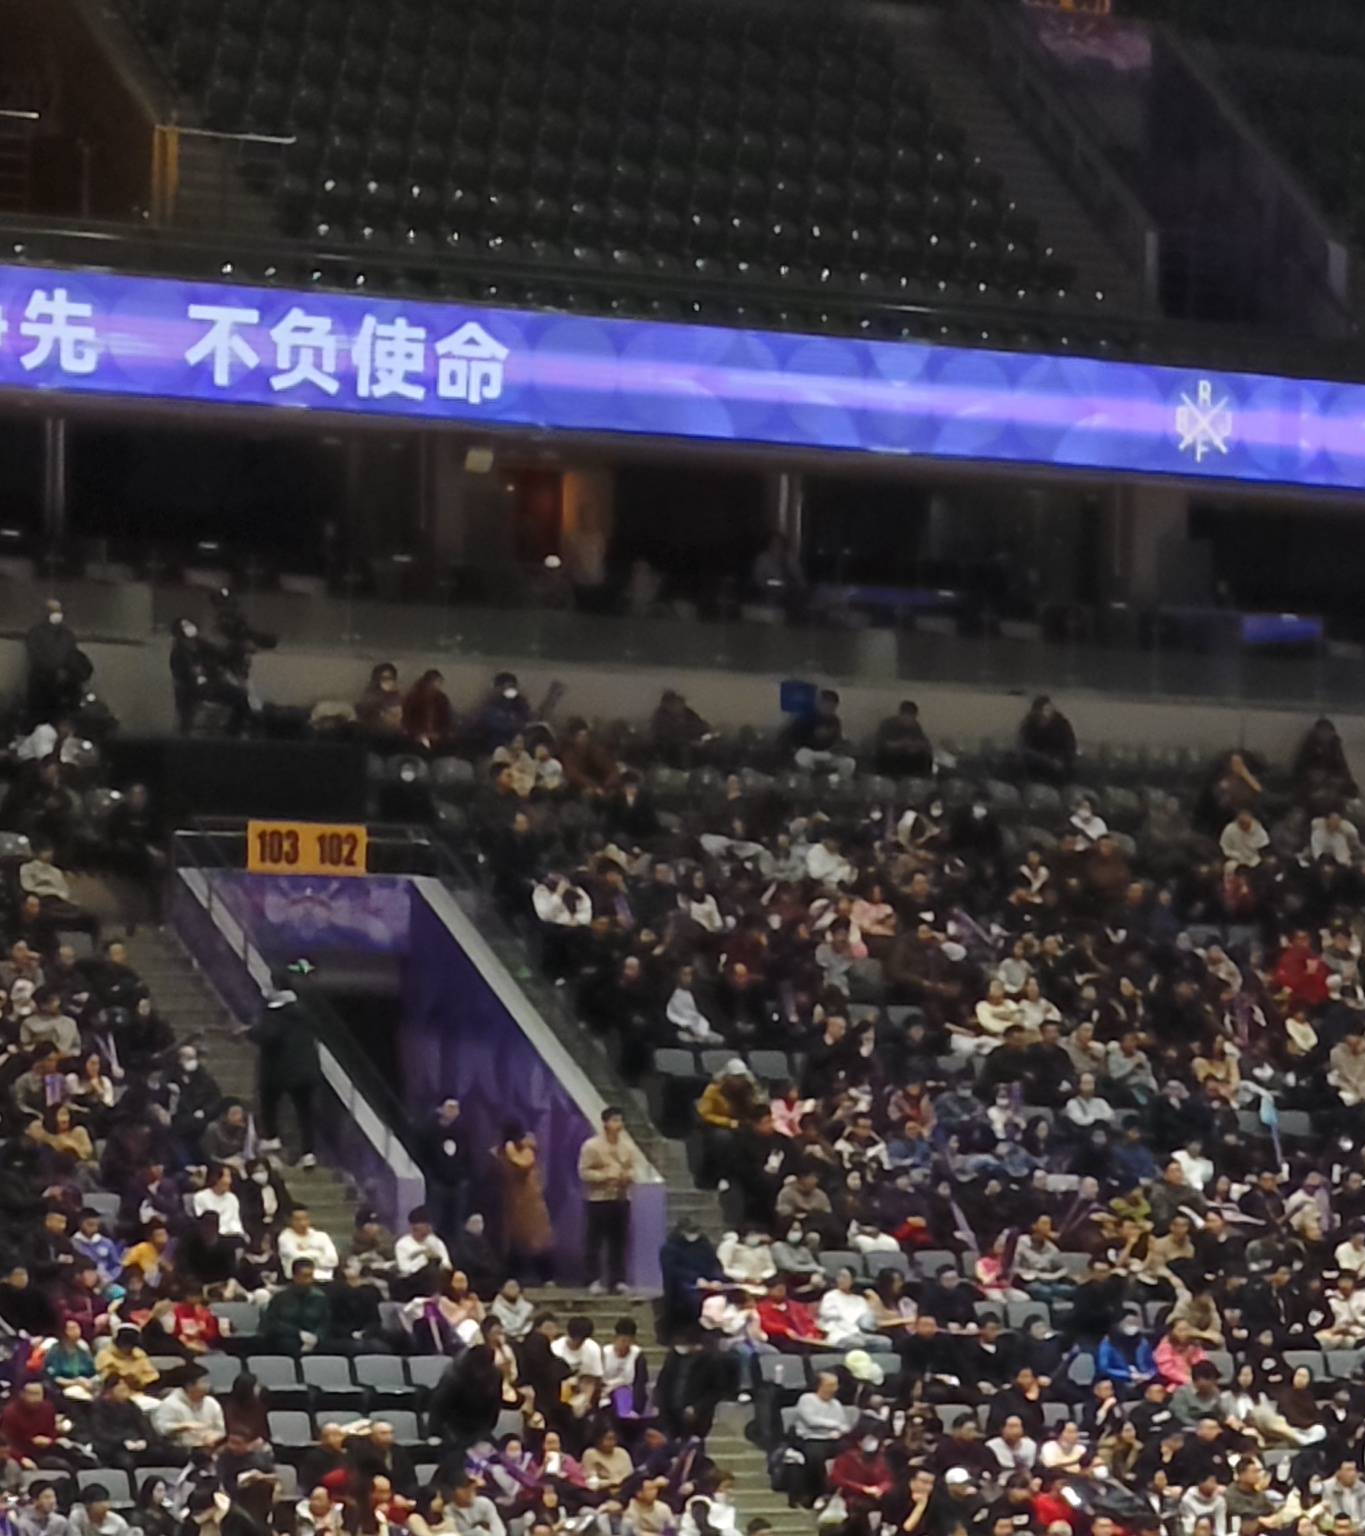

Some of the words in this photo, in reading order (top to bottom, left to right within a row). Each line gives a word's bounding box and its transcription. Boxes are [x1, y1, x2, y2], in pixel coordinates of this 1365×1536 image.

[0, 288, 97, 374] 先
[184, 302, 509, 405] 不负使命
[257, 828, 300, 866] 103
[315, 831, 358, 869] 102
